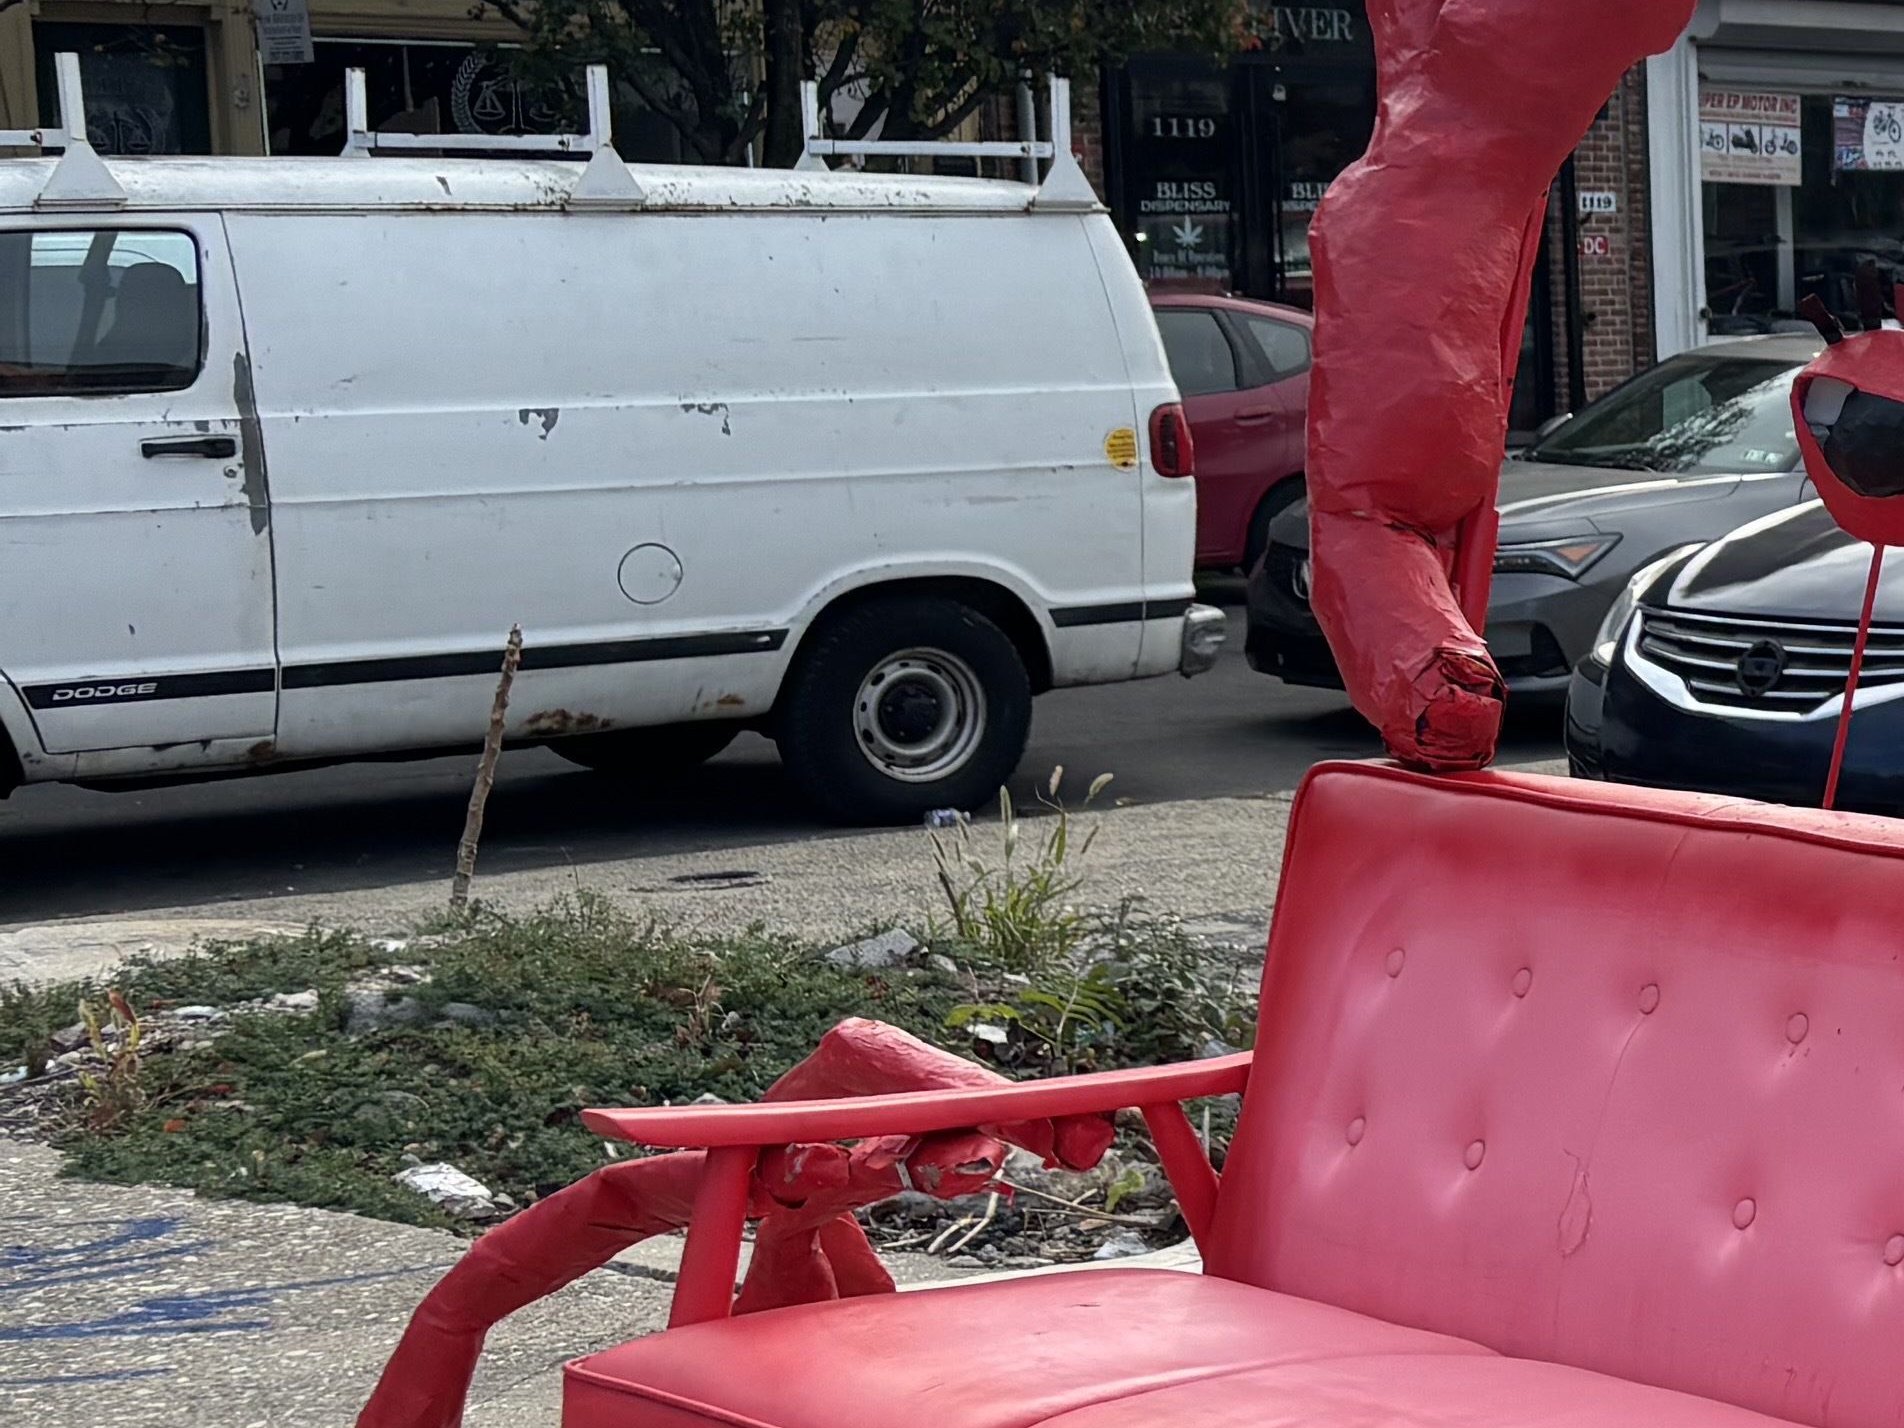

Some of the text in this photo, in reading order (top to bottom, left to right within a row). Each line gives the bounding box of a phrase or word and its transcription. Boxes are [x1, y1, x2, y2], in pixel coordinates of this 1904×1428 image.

[1742, 96, 1777, 112] MOTOR
[1152, 118, 1216, 138] 1119
[1156, 182, 1216, 199] BLISS
[1140, 200, 1231, 212] DISPENSARY
[1582, 196, 1612, 209] 1119
[52, 682, 158, 701] DODGE
